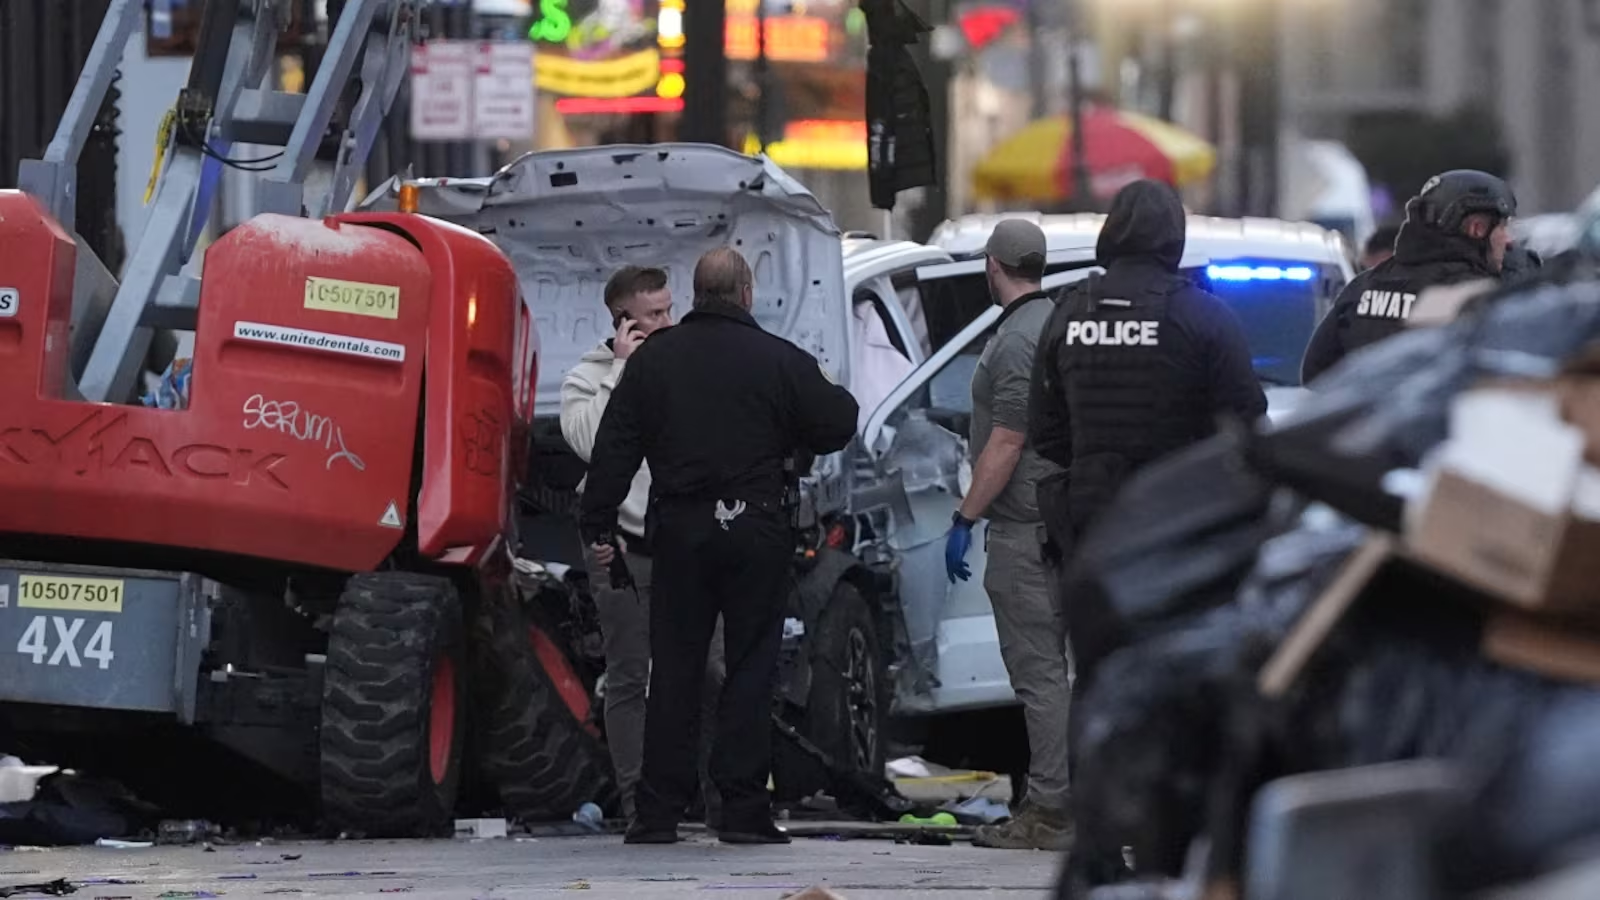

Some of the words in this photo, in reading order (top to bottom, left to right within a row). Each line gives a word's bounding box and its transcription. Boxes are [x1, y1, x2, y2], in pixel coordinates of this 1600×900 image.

[307, 279, 396, 310] 10507501
[1356, 289, 1417, 319] SWAT
[238, 326, 401, 358] www.unitedrentals.com
[1066, 320, 1160, 346] POLICE
[20, 581, 120, 603] 10507501
[17, 615, 115, 669] 4X4
